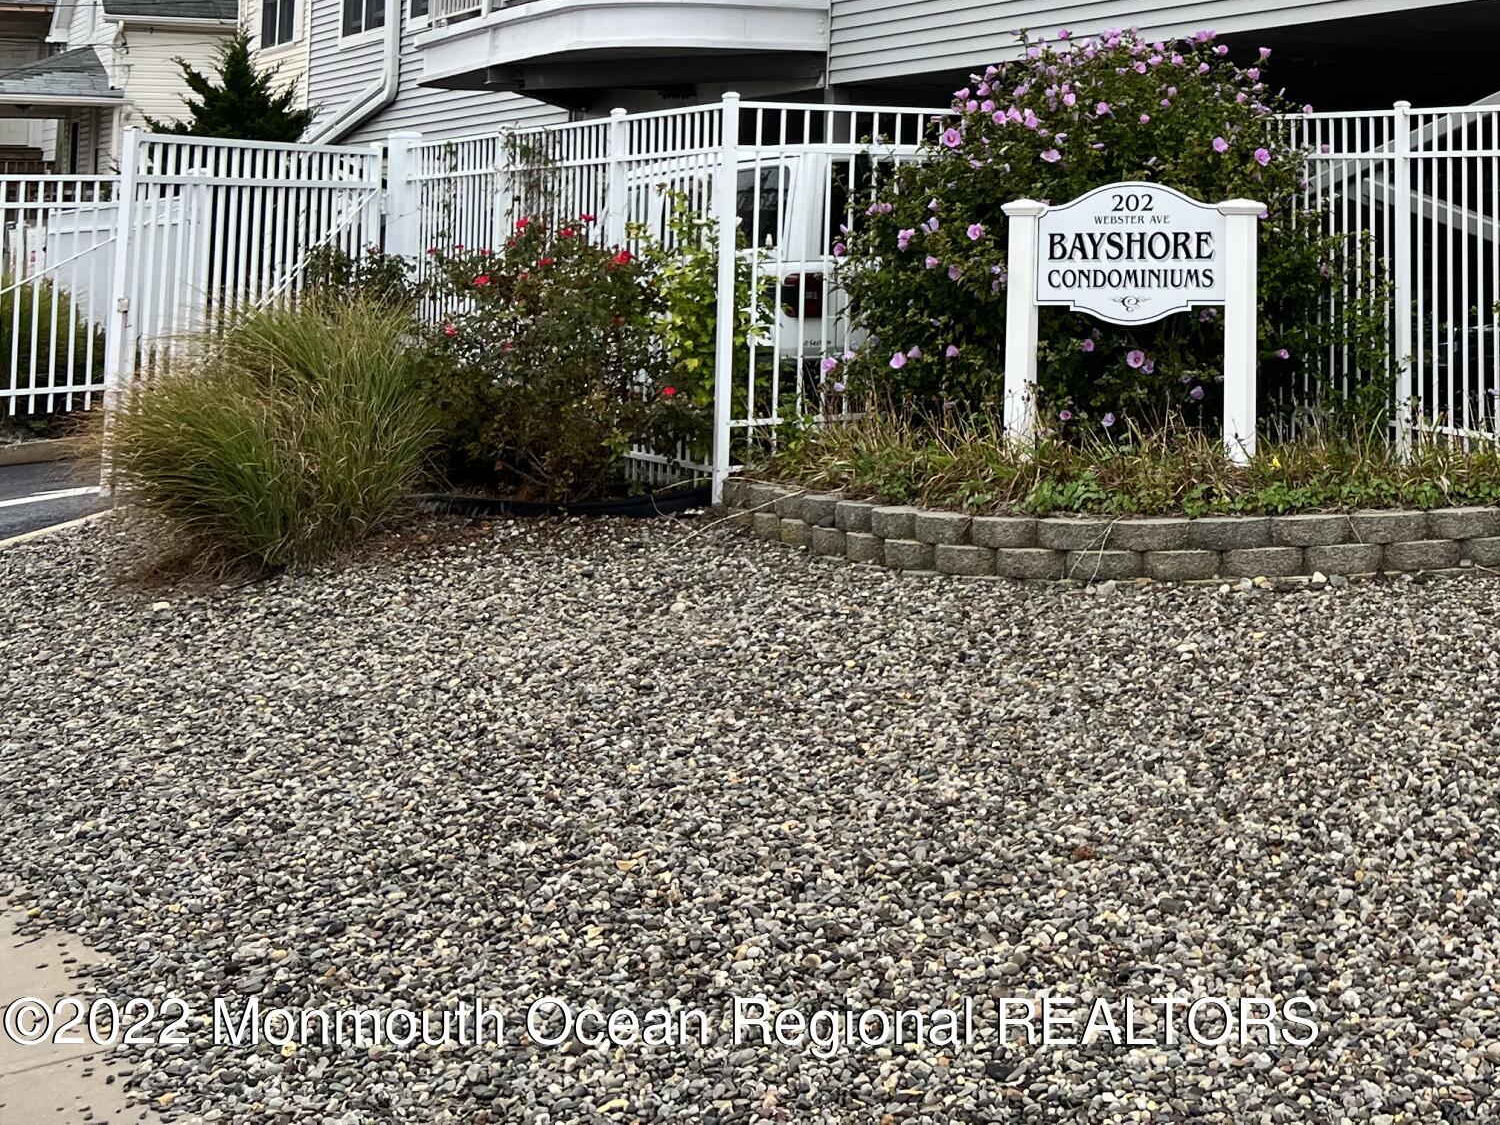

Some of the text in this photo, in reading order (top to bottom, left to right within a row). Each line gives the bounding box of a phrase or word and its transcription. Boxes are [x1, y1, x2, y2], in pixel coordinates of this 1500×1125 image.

[1111, 193, 1153, 212] 202
[1094, 215, 1170, 225] WEBSTER AVE
[1048, 231, 1215, 261] BAYSHORE
[1047, 268, 1215, 289] CONDOMINIUMS
